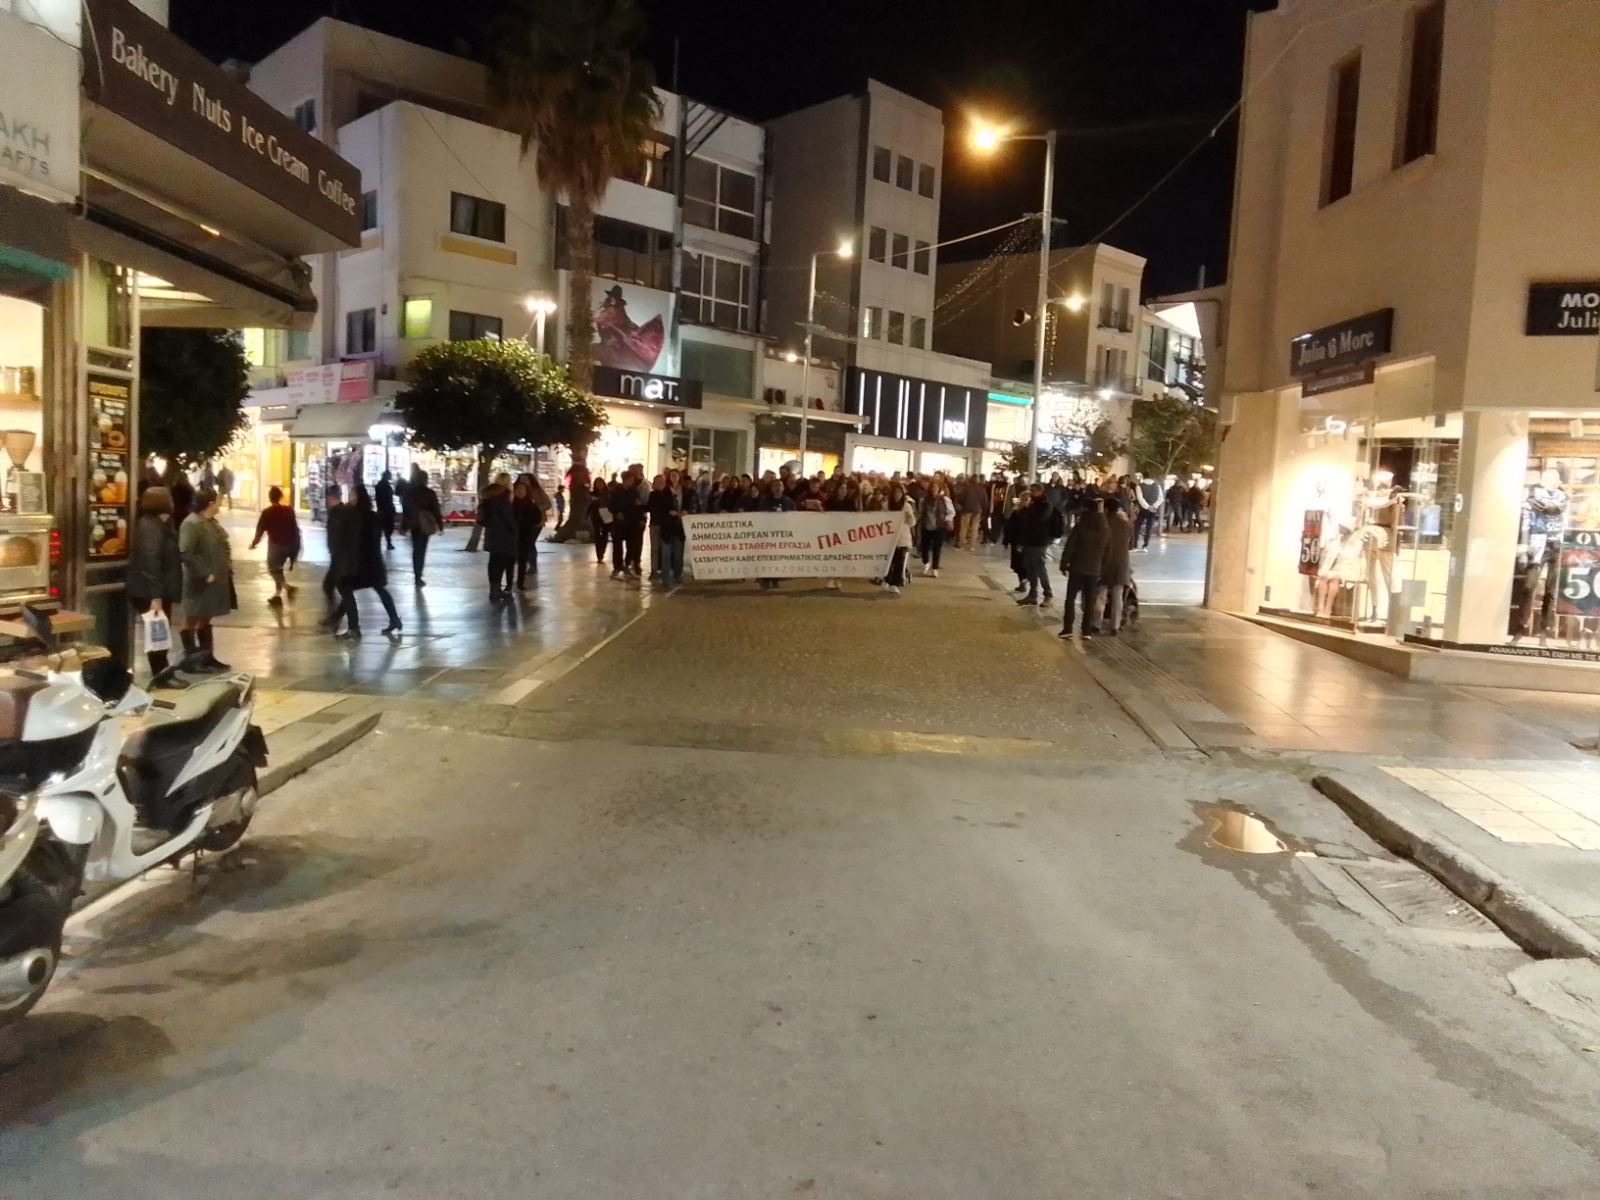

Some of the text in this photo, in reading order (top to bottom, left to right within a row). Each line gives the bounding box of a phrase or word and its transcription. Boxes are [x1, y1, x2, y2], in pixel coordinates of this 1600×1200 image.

[111, 26, 355, 215] Bakery Nuts Ice Cream Coffee
[1298, 340, 1326, 366] Julia
[1340, 329, 1374, 353] More
[690, 520, 754, 530] ΑΠΟΚΛΕΙΣΤΙΚΑ
[817, 520, 896, 550] ΓΙΑ ΟΛΟΥΣ
[691, 530, 794, 541] ΔΗΜΟΣΙΑ ΔΩΡΕΑΝ ΥΓΕΙΑ
[691, 543, 729, 552] ΜΟΝΙΜΗ
[738, 541, 777, 551] ΣΤΑΘΕΡΗ
[778, 541, 812, 550] ΕΡΓΑΣΙΑ
